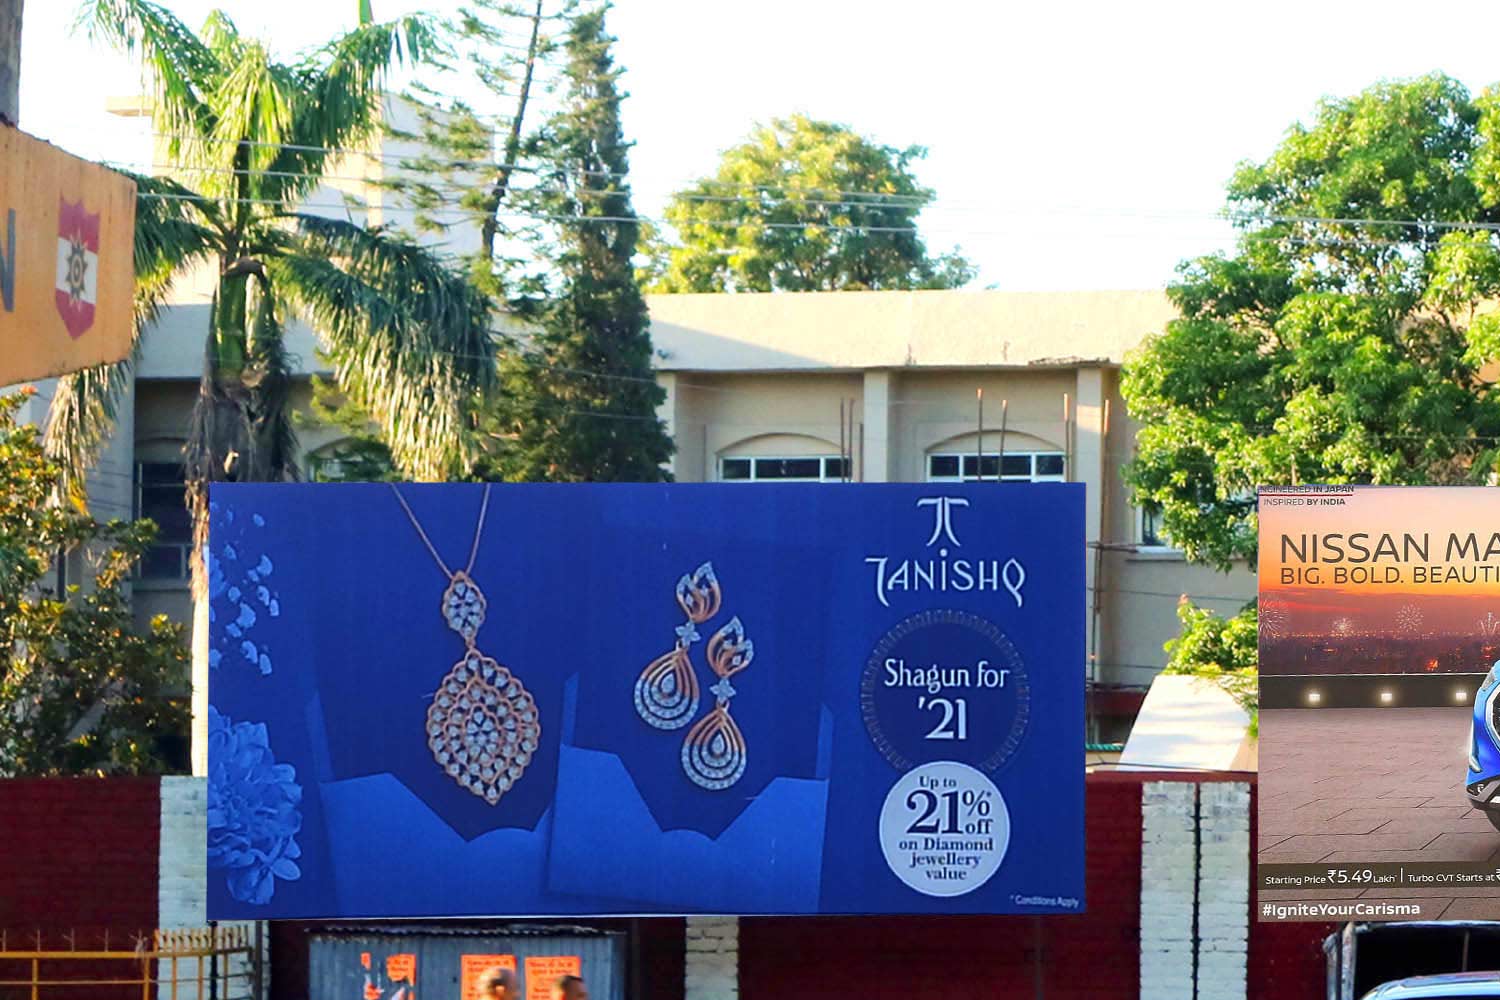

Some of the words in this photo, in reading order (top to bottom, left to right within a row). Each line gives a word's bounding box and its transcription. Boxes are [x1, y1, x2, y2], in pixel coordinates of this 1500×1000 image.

[1306, 498, 1319, 506] BY
[1281, 534, 1429, 563] NISSAN
[865, 548, 1026, 608] TANISHQ
[1280, 568, 1326, 584] BIG.
[1334, 566, 1404, 583] BOLD.
[884, 658, 970, 694] Shagun
[976, 660, 1011, 688] for
[919, 775, 939, 790] Up
[943, 778, 957, 787] to
[965, 818, 994, 835] off
[899, 840, 918, 851] on
[924, 837, 994, 851] Diamond
[909, 851, 982, 869] jewellery
[926, 866, 968, 880] value
[1265, 876, 1302, 885] Starting
[1304, 875, 1326, 884] Price
[1408, 874, 1434, 882] Turbo
[1435, 874, 1454, 882] CVT
[1456, 873, 1484, 882] Starts
[1263, 903, 1420, 918] #IgniteYourCarisma
